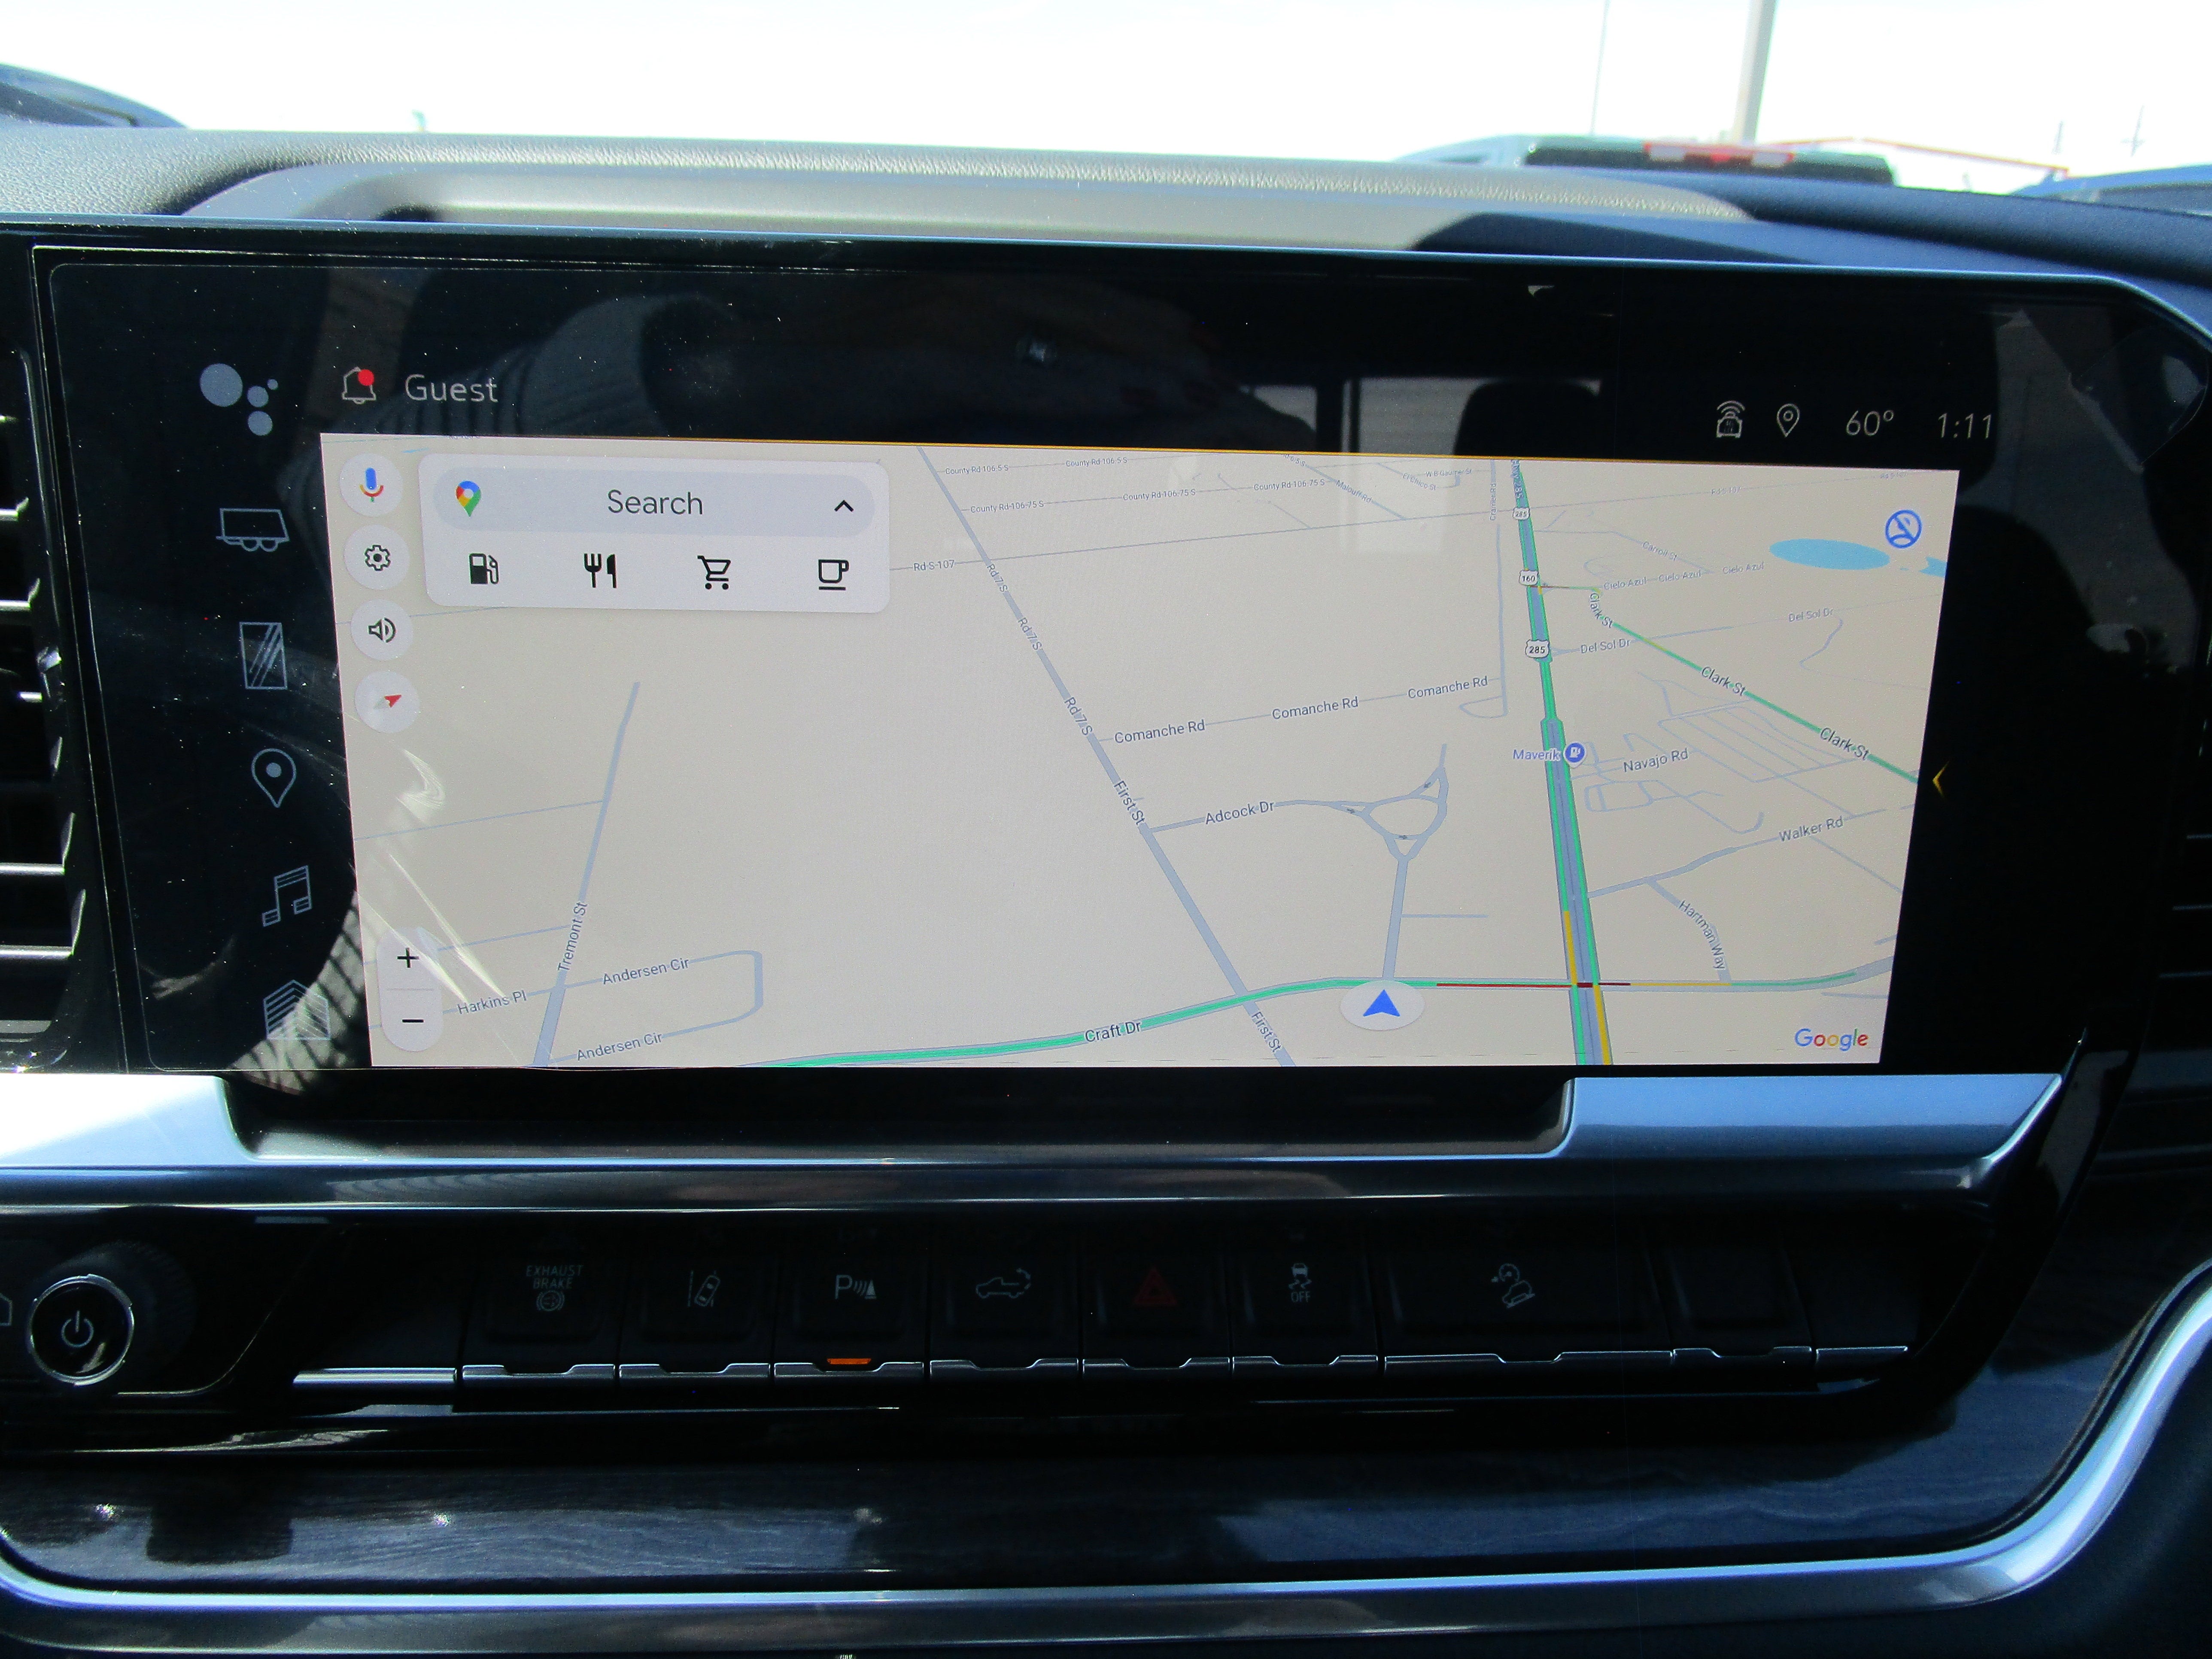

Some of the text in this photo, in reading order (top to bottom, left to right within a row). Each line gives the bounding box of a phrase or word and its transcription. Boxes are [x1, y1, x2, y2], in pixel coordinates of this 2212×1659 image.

[405, 374, 498, 402] Guest
[1938, 413, 1992, 439] 1:11
[1163, 489, 1189, 498] 106.75
[1253, 483, 1279, 491] County
[1293, 479, 1319, 488] 106.75
[1336, 480, 1371, 503] Malouff Rd
[607, 489, 703, 515] Search
[970, 505, 997, 513] County
[1010, 501, 1037, 510] 106.75
[1642, 542, 1668, 558] Carroll
[913, 559, 954, 571] Rd S 107
[1659, 570, 1701, 582] Cielo Azul
[1723, 562, 1764, 574] Cielo Azul
[986, 563, 1008, 593] Rd 7 S
[1604, 577, 1646, 590] Cielo Azul
[1589, 592, 1613, 629] Clark St
[1789, 608, 1833, 623] Del Sol Dr
[1017, 617, 1030, 633] Rd
[1032, 641, 1042, 650] S
[1581, 639, 1630, 654] Del Sol Dr
[1408, 676, 1488, 699] Comanche Rd
[1702, 666, 1745, 696] Clark St
[1064, 696, 1093, 735] Rd 7 S
[1272, 696, 1358, 720] Comanche Rd
[1115, 719, 1206, 744] Comanche Rd
[1513, 749, 1561, 760] Maverik
[1820, 728, 1869, 760] Clark St
[1623, 748, 1688, 773] Navajo Rd
[1114, 781, 1146, 825] First St
[1206, 802, 1275, 824] Adcock Dr
[1779, 816, 1844, 842] Walker Rd
[558, 901, 588, 972] Tremont St
[1679, 899, 1725, 970] Hartman Way
[603, 957, 690, 985] Andersen Cir
[458, 990, 526, 1015] Harkins Pl
[1085, 1020, 1141, 1042] Craft Dr
[1252, 1011, 1282, 1053] First St
[1795, 1028, 1869, 1052] Google
[577, 1033, 663, 1060] Andersen Cir
[526, 1264, 584, 1277] EXHAUST
[532, 1277, 573, 1289] BRAKE
[1291, 1291, 1311, 1303] OFF
